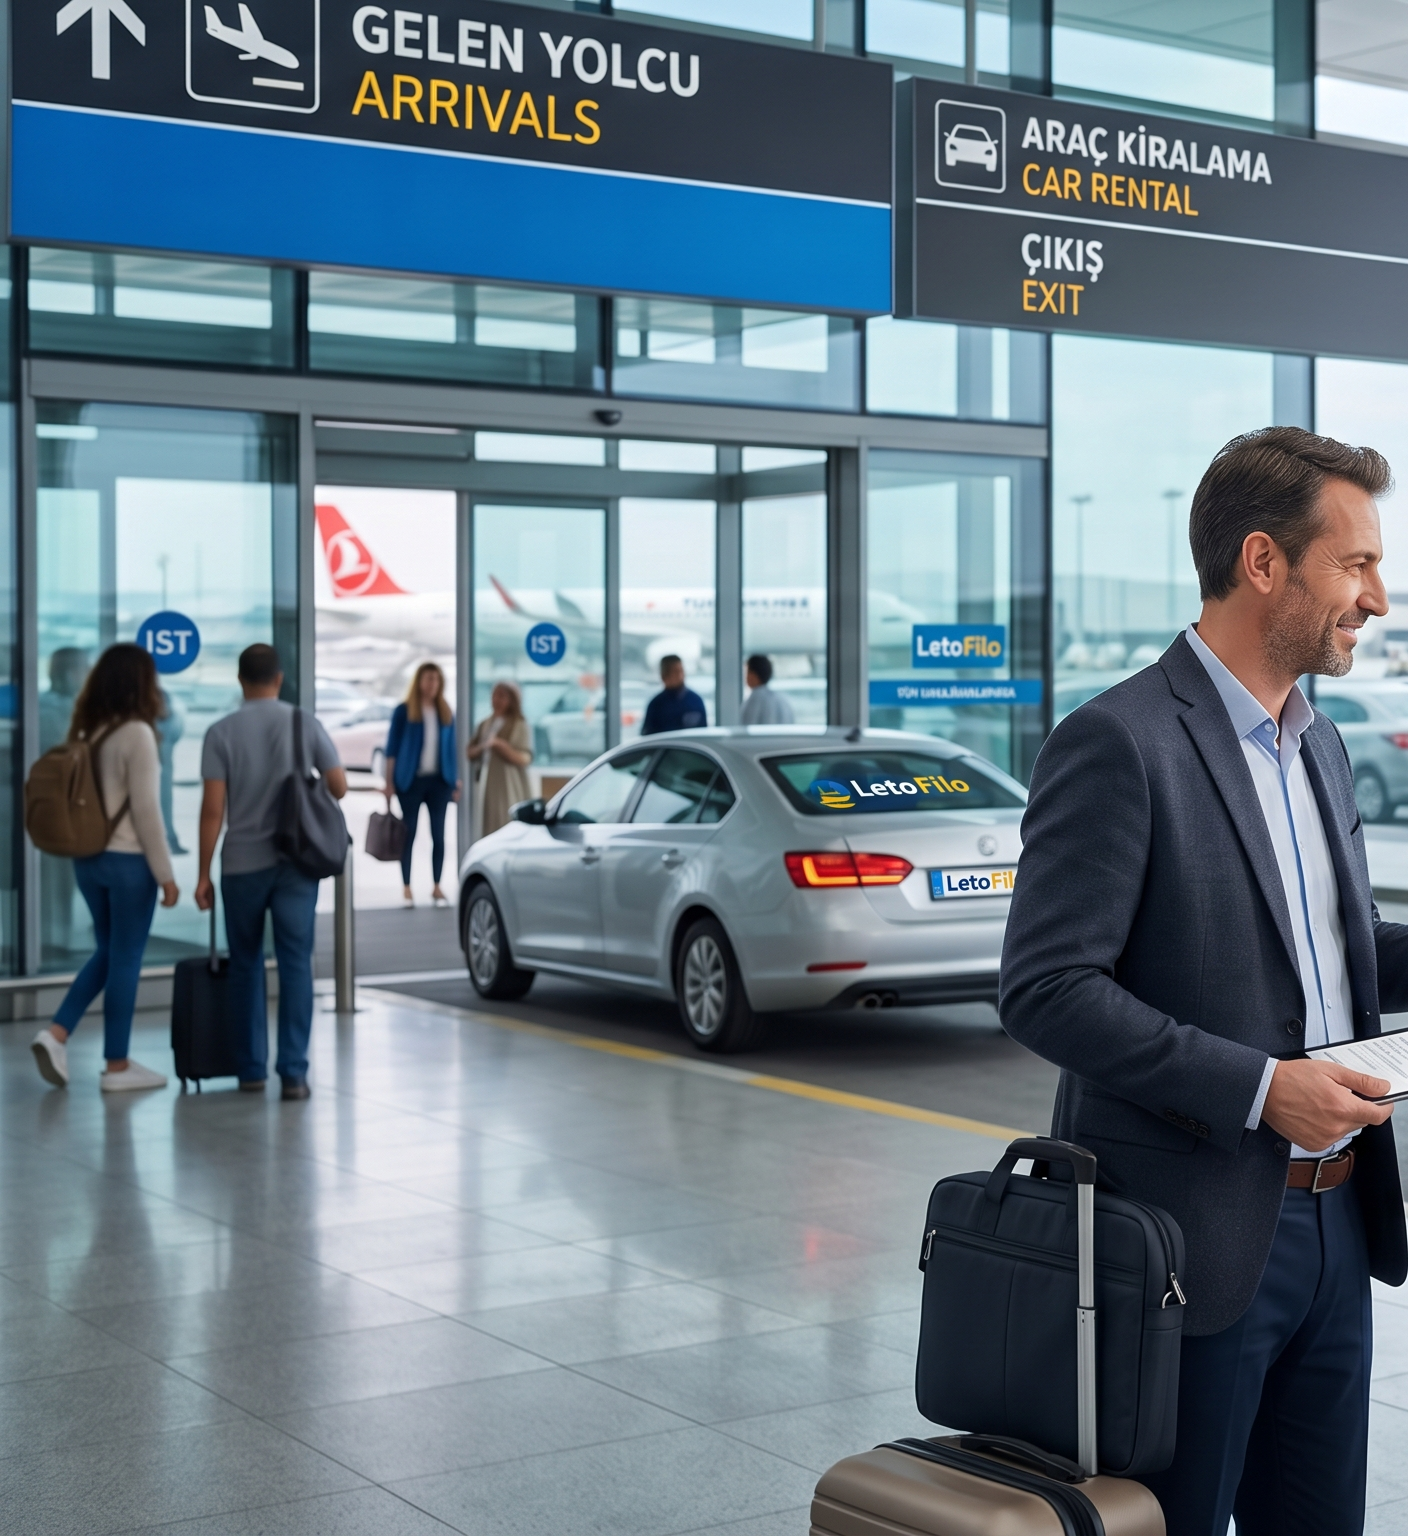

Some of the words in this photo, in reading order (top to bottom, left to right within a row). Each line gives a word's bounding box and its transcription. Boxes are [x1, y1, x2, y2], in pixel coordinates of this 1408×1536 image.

[352, 5, 524, 74] GELEN
[539, 32, 701, 98] YOLCU
[351, 69, 602, 146] ARRIVALS
[1022, 116, 1108, 167] ARAÇ
[1117, 125, 1272, 185] KİRALAMA
[1023, 163, 1082, 201] CAR
[1091, 173, 1198, 217] RENTAL
[1021, 233, 1103, 281] ÇIKIŞ
[1023, 280, 1084, 316] EXIT
[146, 629, 193, 655] IST
[531, 635, 561, 654] IST
[916, 634, 1002, 658] LetoFilo
[850, 775, 970, 798] LetoFilo
[946, 870, 1014, 892] LetoFil
